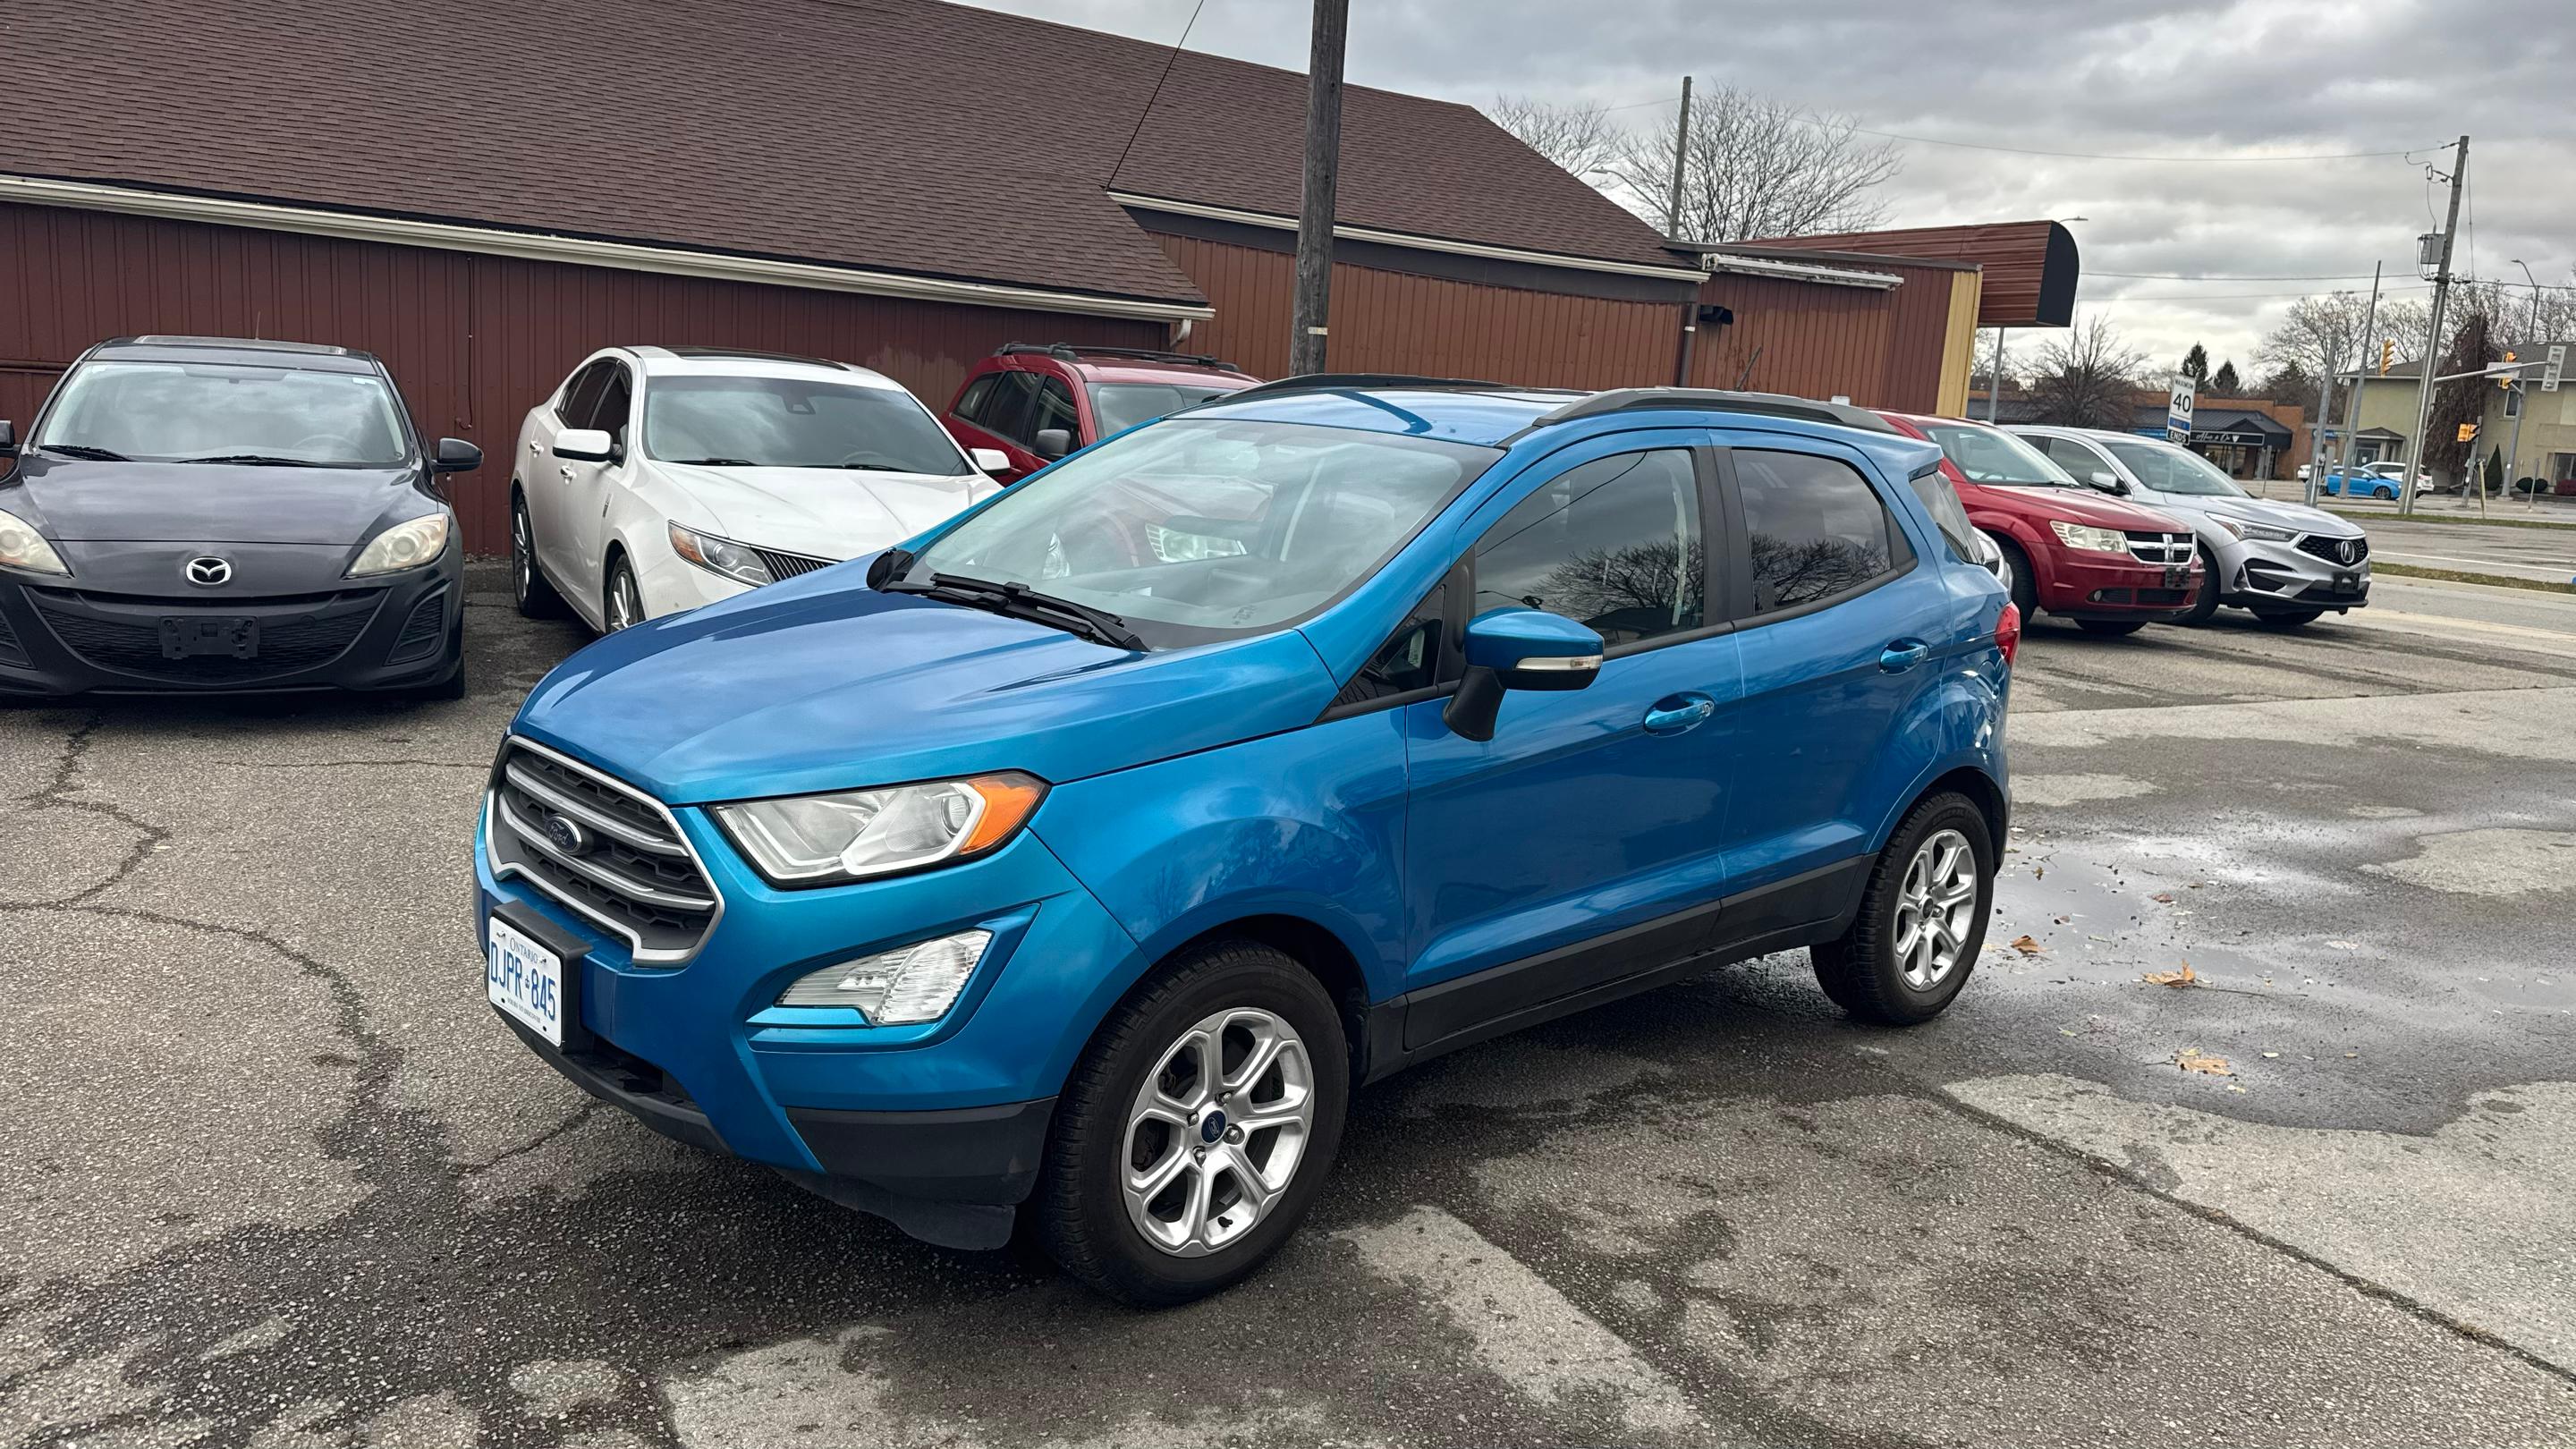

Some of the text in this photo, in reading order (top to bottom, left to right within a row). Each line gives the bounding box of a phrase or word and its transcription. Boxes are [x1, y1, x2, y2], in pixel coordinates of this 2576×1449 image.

[2173, 393, 2191, 413] 40
[2170, 430, 2187, 445] ENDS
[549, 822, 569, 845] Ford
[531, 968, 556, 1021] 845
